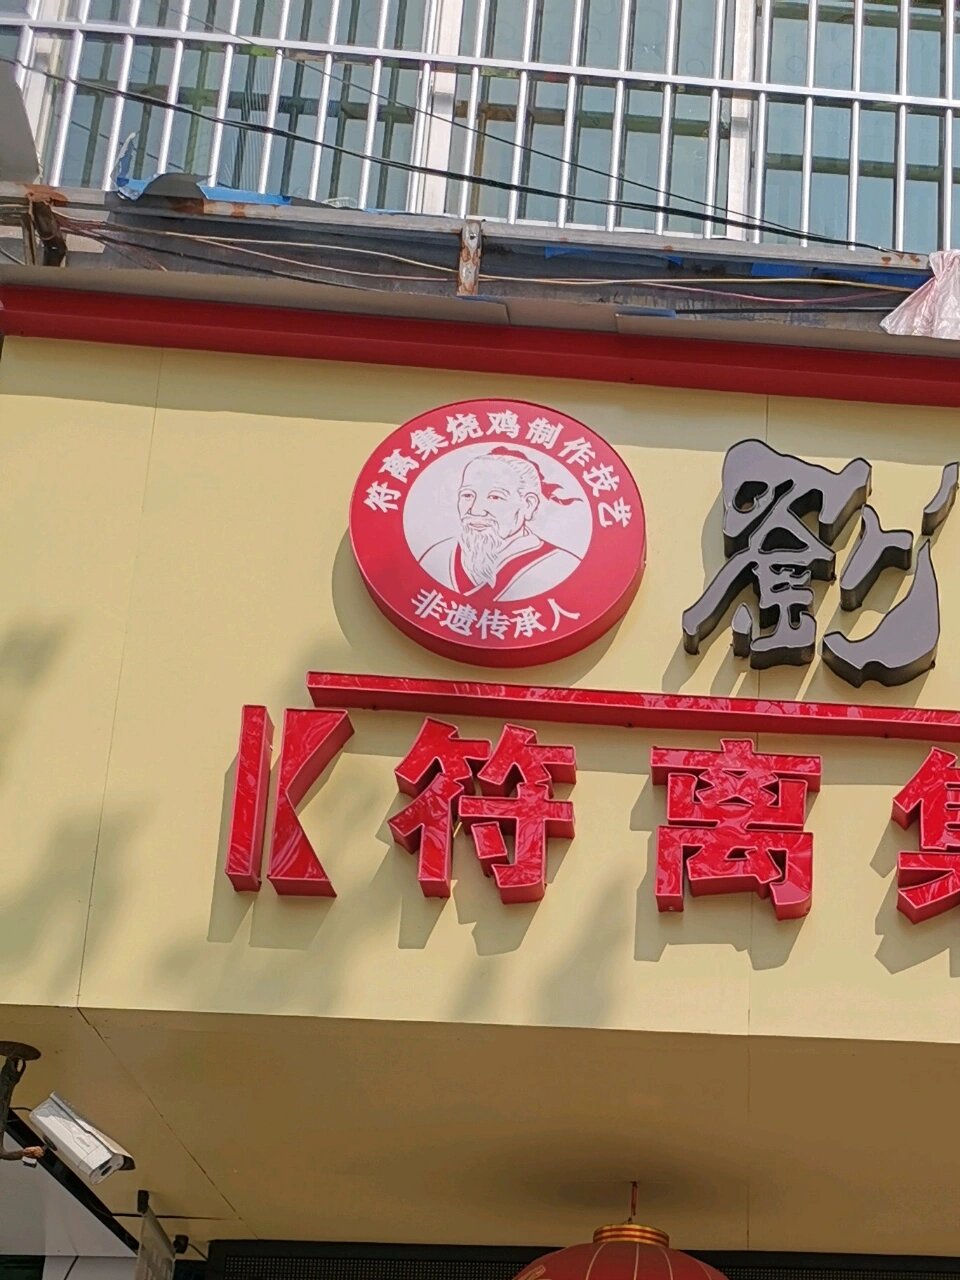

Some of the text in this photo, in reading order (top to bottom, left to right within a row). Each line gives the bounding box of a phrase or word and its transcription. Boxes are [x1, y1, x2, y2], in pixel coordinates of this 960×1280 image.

[363, 409, 632, 528] 符离集烧鸡制作技艺
[411, 588, 580, 640] 非遗传承人
